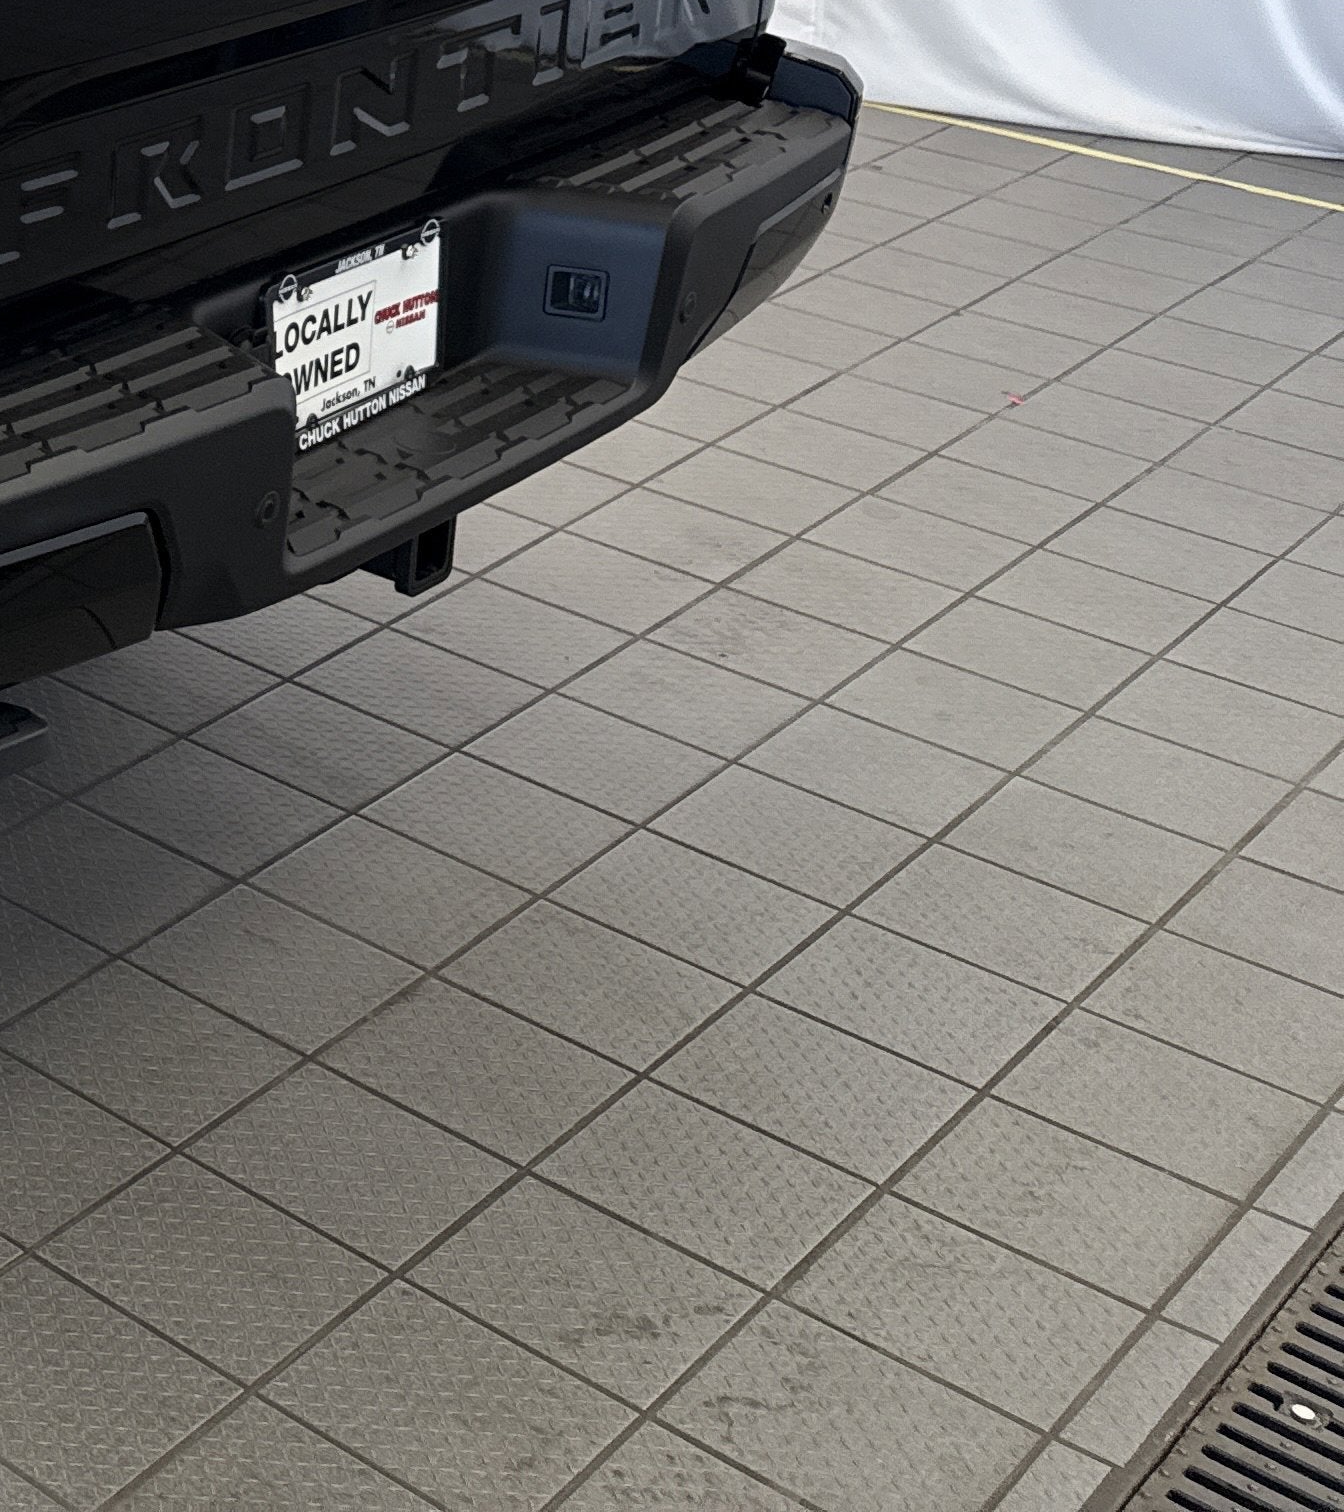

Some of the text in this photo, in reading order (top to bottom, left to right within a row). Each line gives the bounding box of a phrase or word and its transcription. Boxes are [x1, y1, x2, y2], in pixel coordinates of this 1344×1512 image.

[284, 342, 360, 396] WNED
[363, 376, 377, 392] TN
[299, 374, 426, 451] CHUCK HUTTON NISSAN
